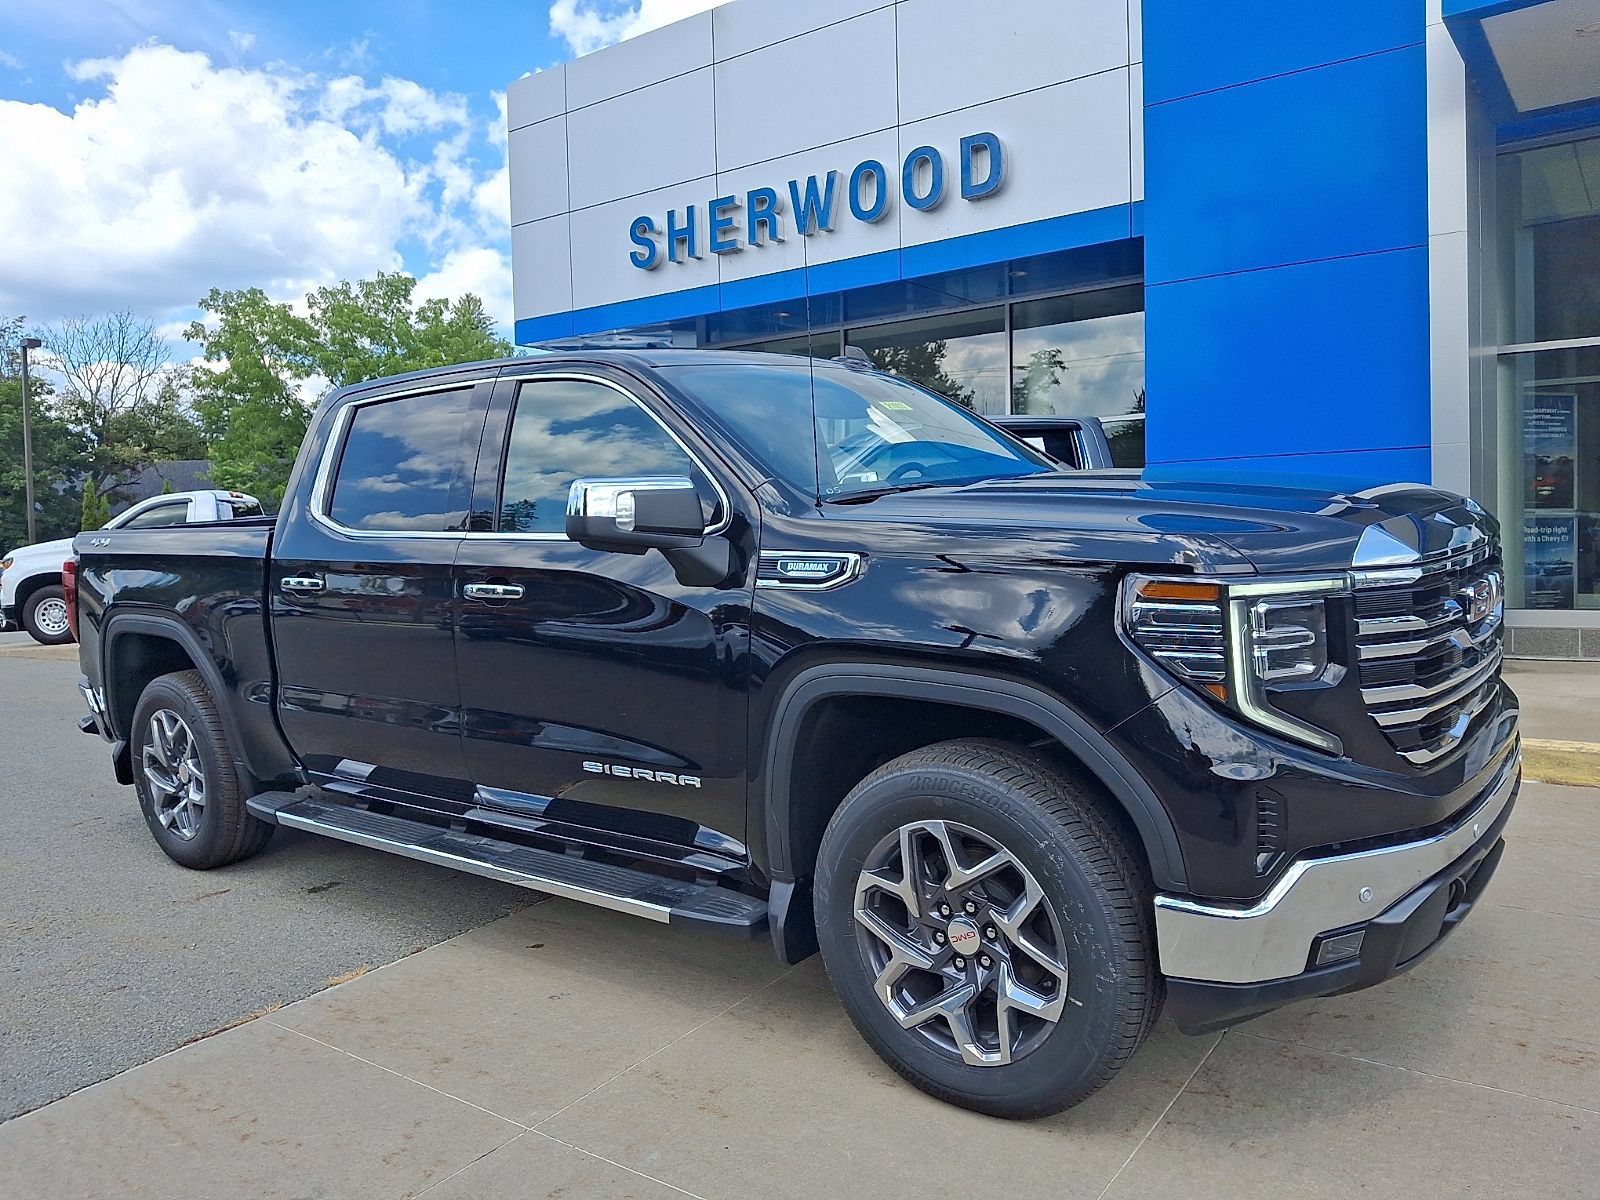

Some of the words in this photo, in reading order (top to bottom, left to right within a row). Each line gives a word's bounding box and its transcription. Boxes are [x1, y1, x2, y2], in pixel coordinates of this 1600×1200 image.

[629, 132, 1006, 271] SHERWOOD
[1553, 526, 1568, 534] right
[1542, 535, 1560, 543] Chevy
[787, 562, 829, 572] DURAMAX
[583, 760, 702, 788] SIERRA
[909, 775, 1022, 818] BRIDGESTONE
[950, 930, 976, 943] GMC
